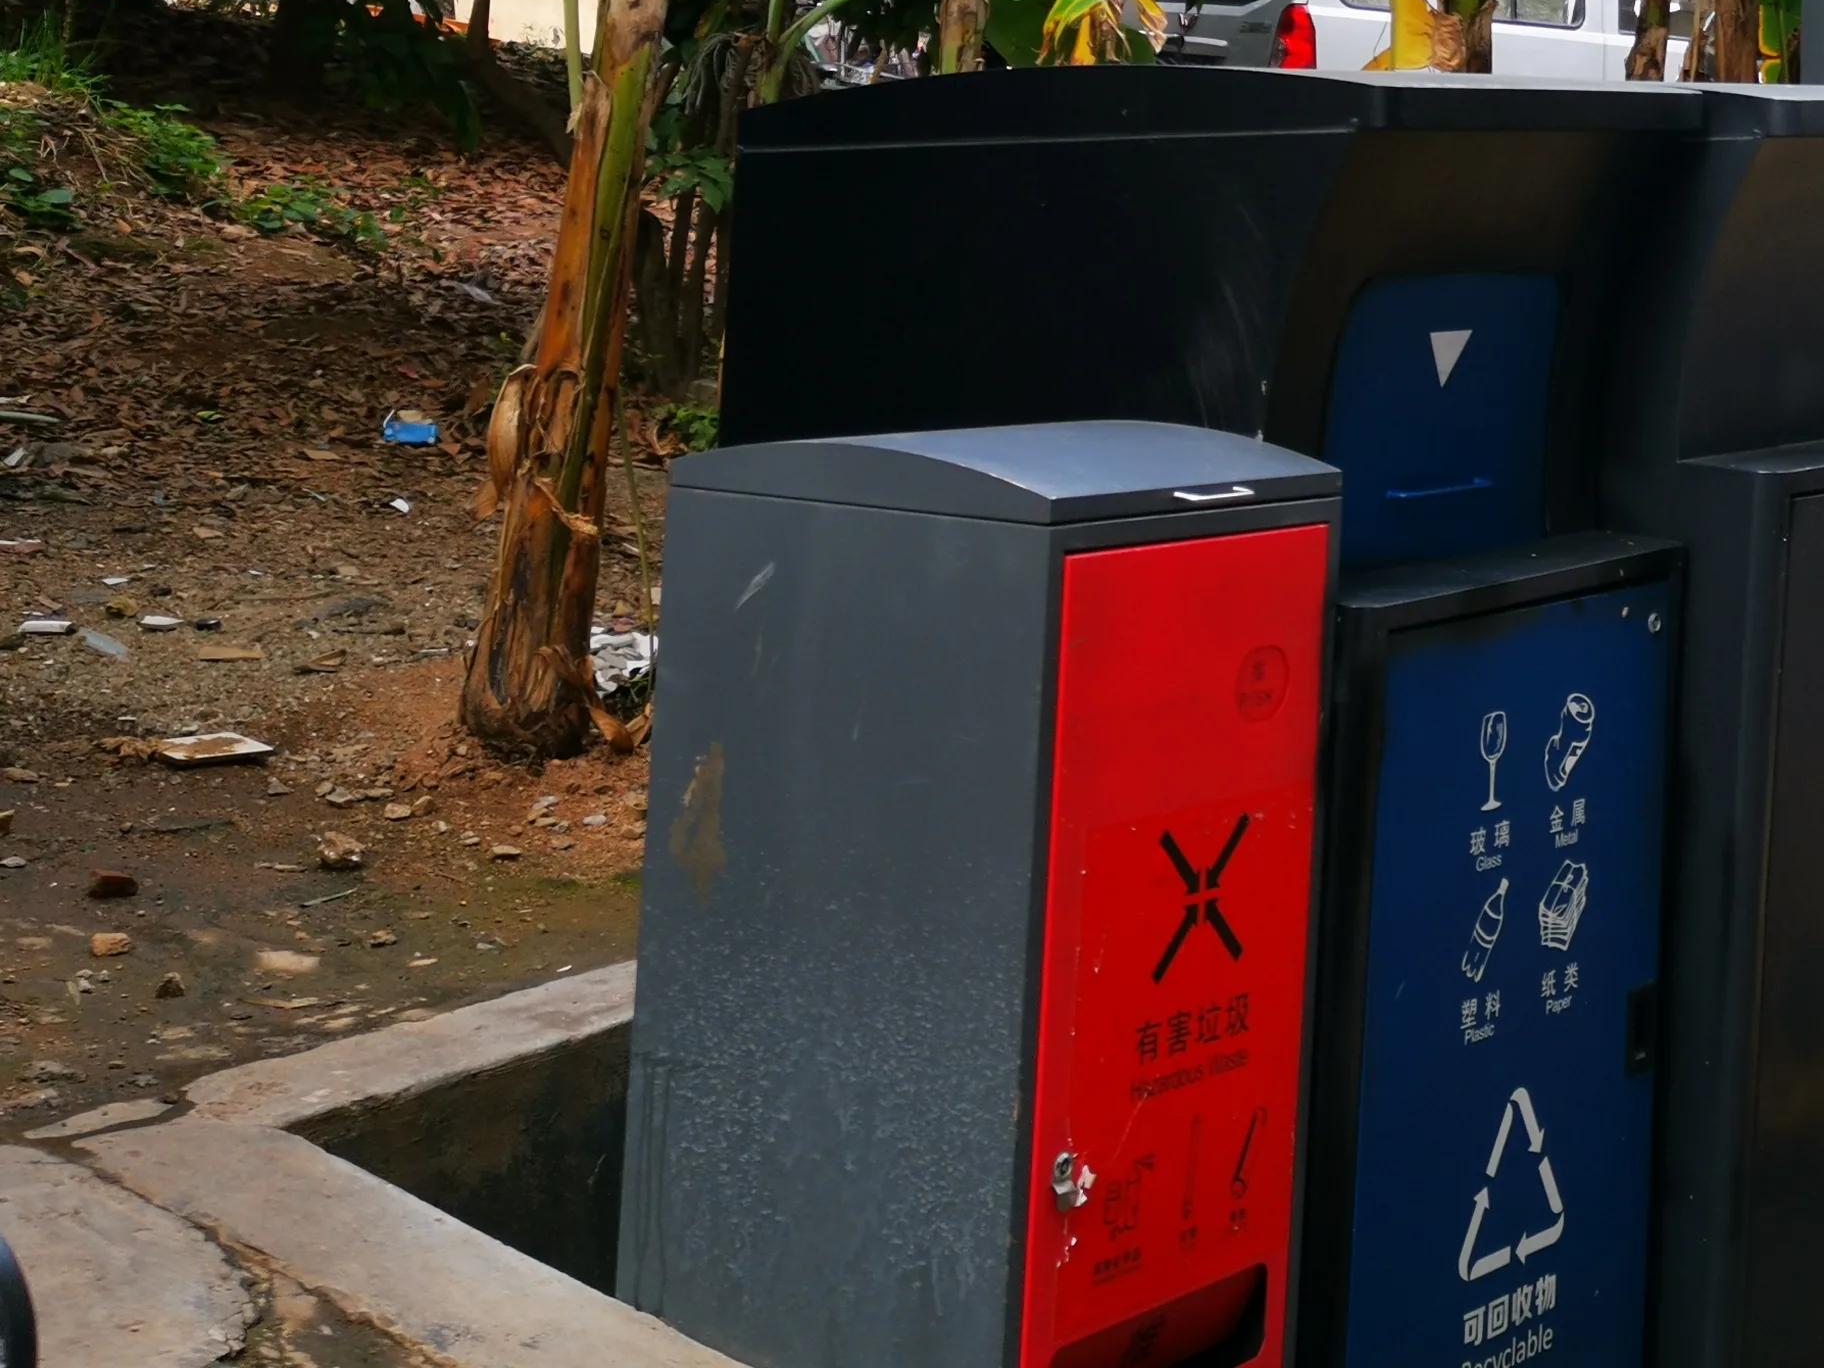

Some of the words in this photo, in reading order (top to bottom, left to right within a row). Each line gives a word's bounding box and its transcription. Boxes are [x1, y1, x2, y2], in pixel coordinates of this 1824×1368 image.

[1550, 798, 1586, 834] 金属
[1469, 820, 1511, 856] 玻璃
[1555, 829, 1579, 848] Metal
[1475, 854, 1503, 872] Glass
[1540, 962, 1579, 998] 纸类
[1460, 990, 1501, 1029] 塑料
[1545, 996, 1573, 1015] Paper
[1136, 993, 1248, 1064] 有害垃圾
[1464, 1022, 1495, 1045] Plastic
[1463, 1273, 1557, 1346] 可回收物
[1461, 1323, 1554, 1368] yclable
